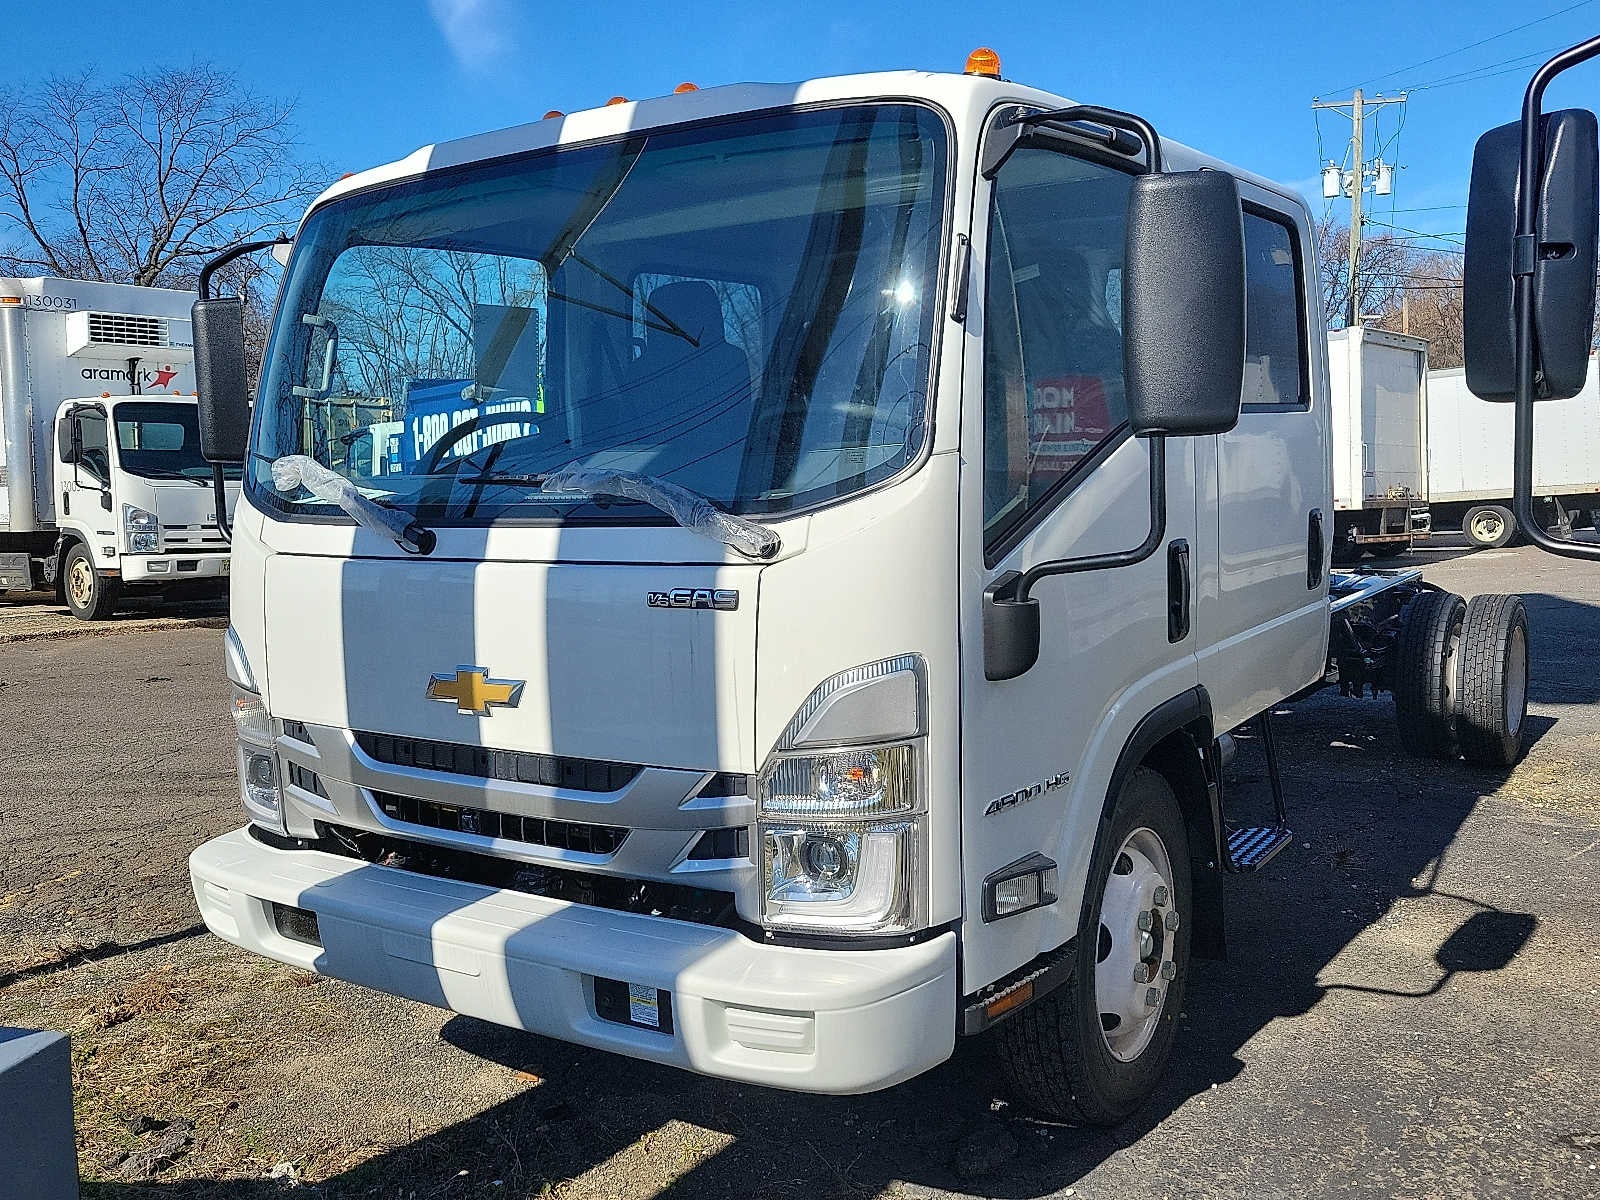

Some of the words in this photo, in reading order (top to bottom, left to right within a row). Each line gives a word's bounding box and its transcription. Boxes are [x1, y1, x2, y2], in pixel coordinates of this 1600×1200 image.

[26, 294, 78, 310] 130031
[81, 367, 153, 383] aramark
[669, 588, 739, 611] GAS
